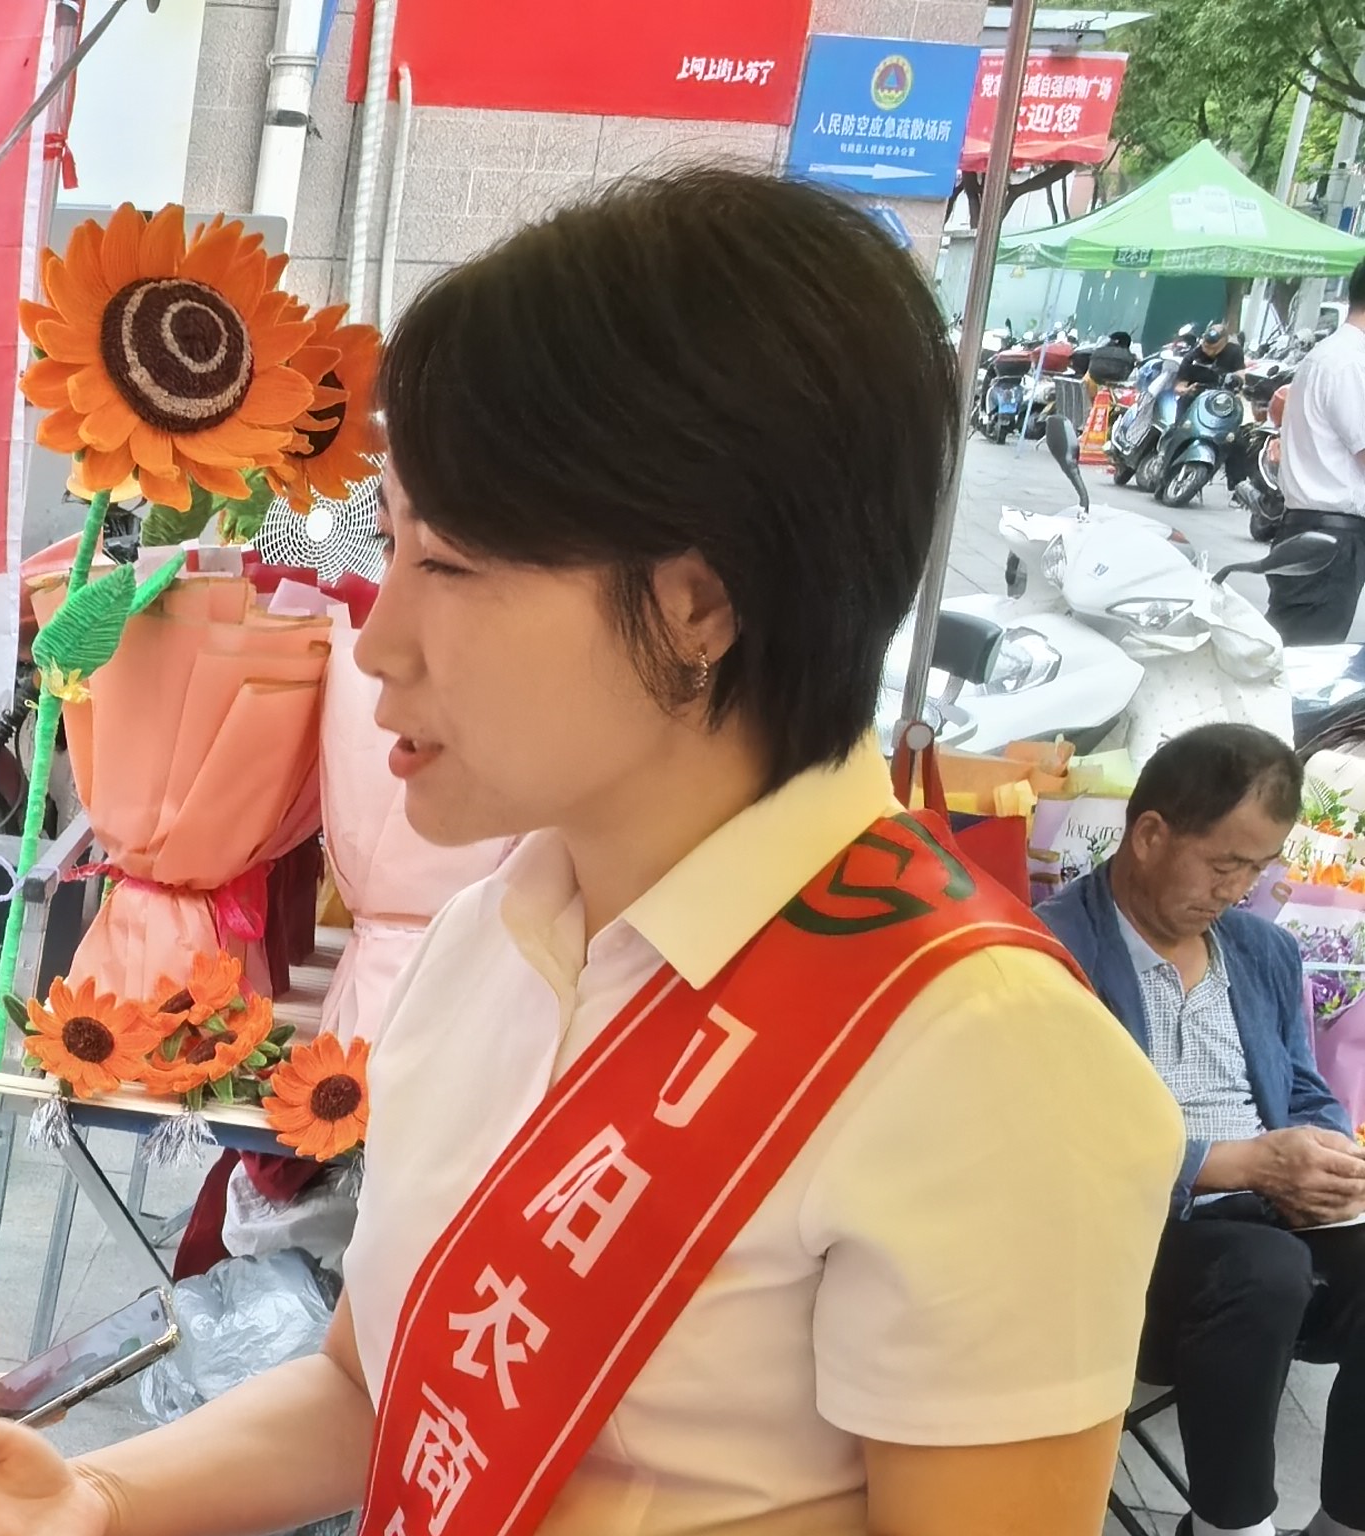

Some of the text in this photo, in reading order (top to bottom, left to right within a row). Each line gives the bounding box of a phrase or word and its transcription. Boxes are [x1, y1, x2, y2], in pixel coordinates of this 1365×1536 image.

[813, 112, 952, 142] 人民防空应急疏散场所
[1017, 103, 1082, 133] 迎您
